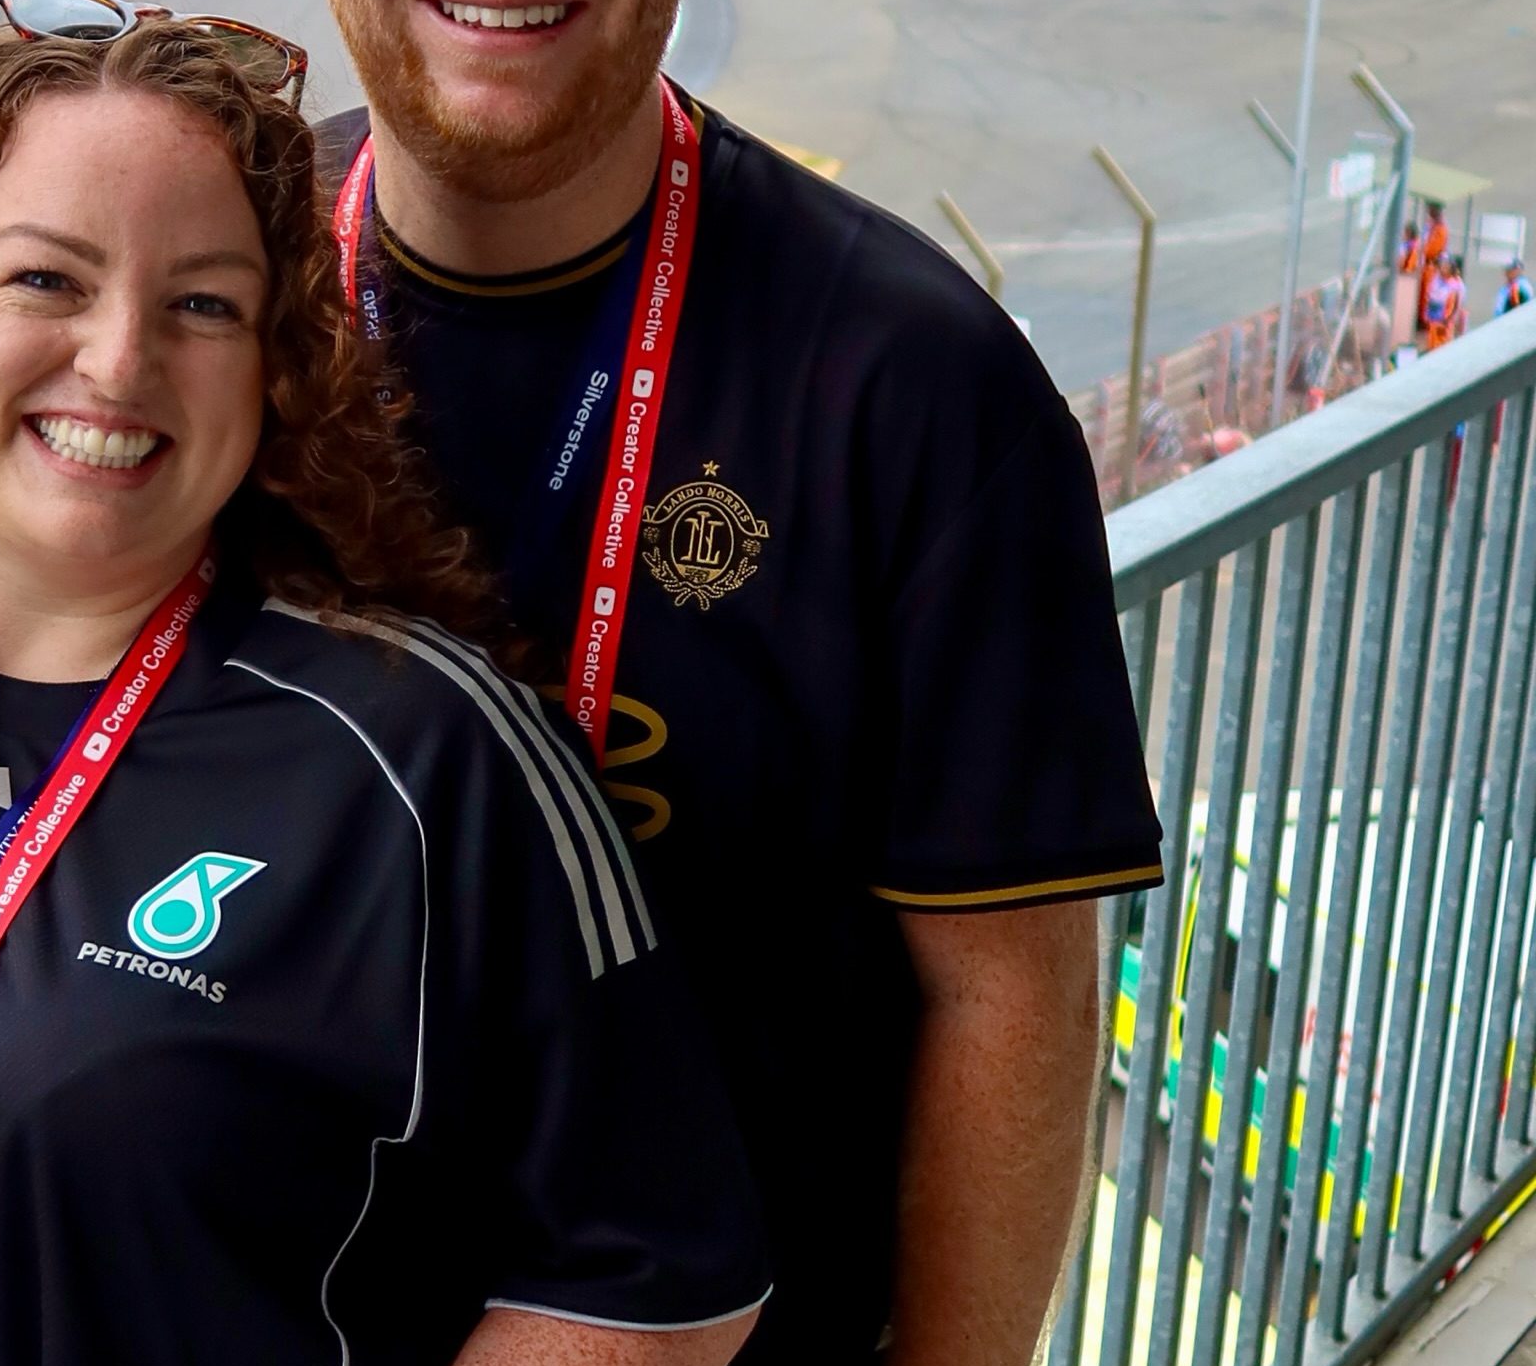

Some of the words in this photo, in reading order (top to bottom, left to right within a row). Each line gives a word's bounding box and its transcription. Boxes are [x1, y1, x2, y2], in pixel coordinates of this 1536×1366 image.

[661, 189, 685, 258] Creator
[641, 261, 674, 352] Collective
[549, 369, 609, 491] Silverstone
[620, 401, 648, 474] Creator
[601, 476, 634, 569] Collective
[663, 486, 704, 514] LANDO
[707, 487, 751, 524] NORRIS
[102, 670, 151, 733] Creator
[141, 593, 201, 670] Collective
[582, 619, 608, 692] Creator
[23, 773, 87, 856] Collective
[76, 941, 227, 1004] PETRONAS
